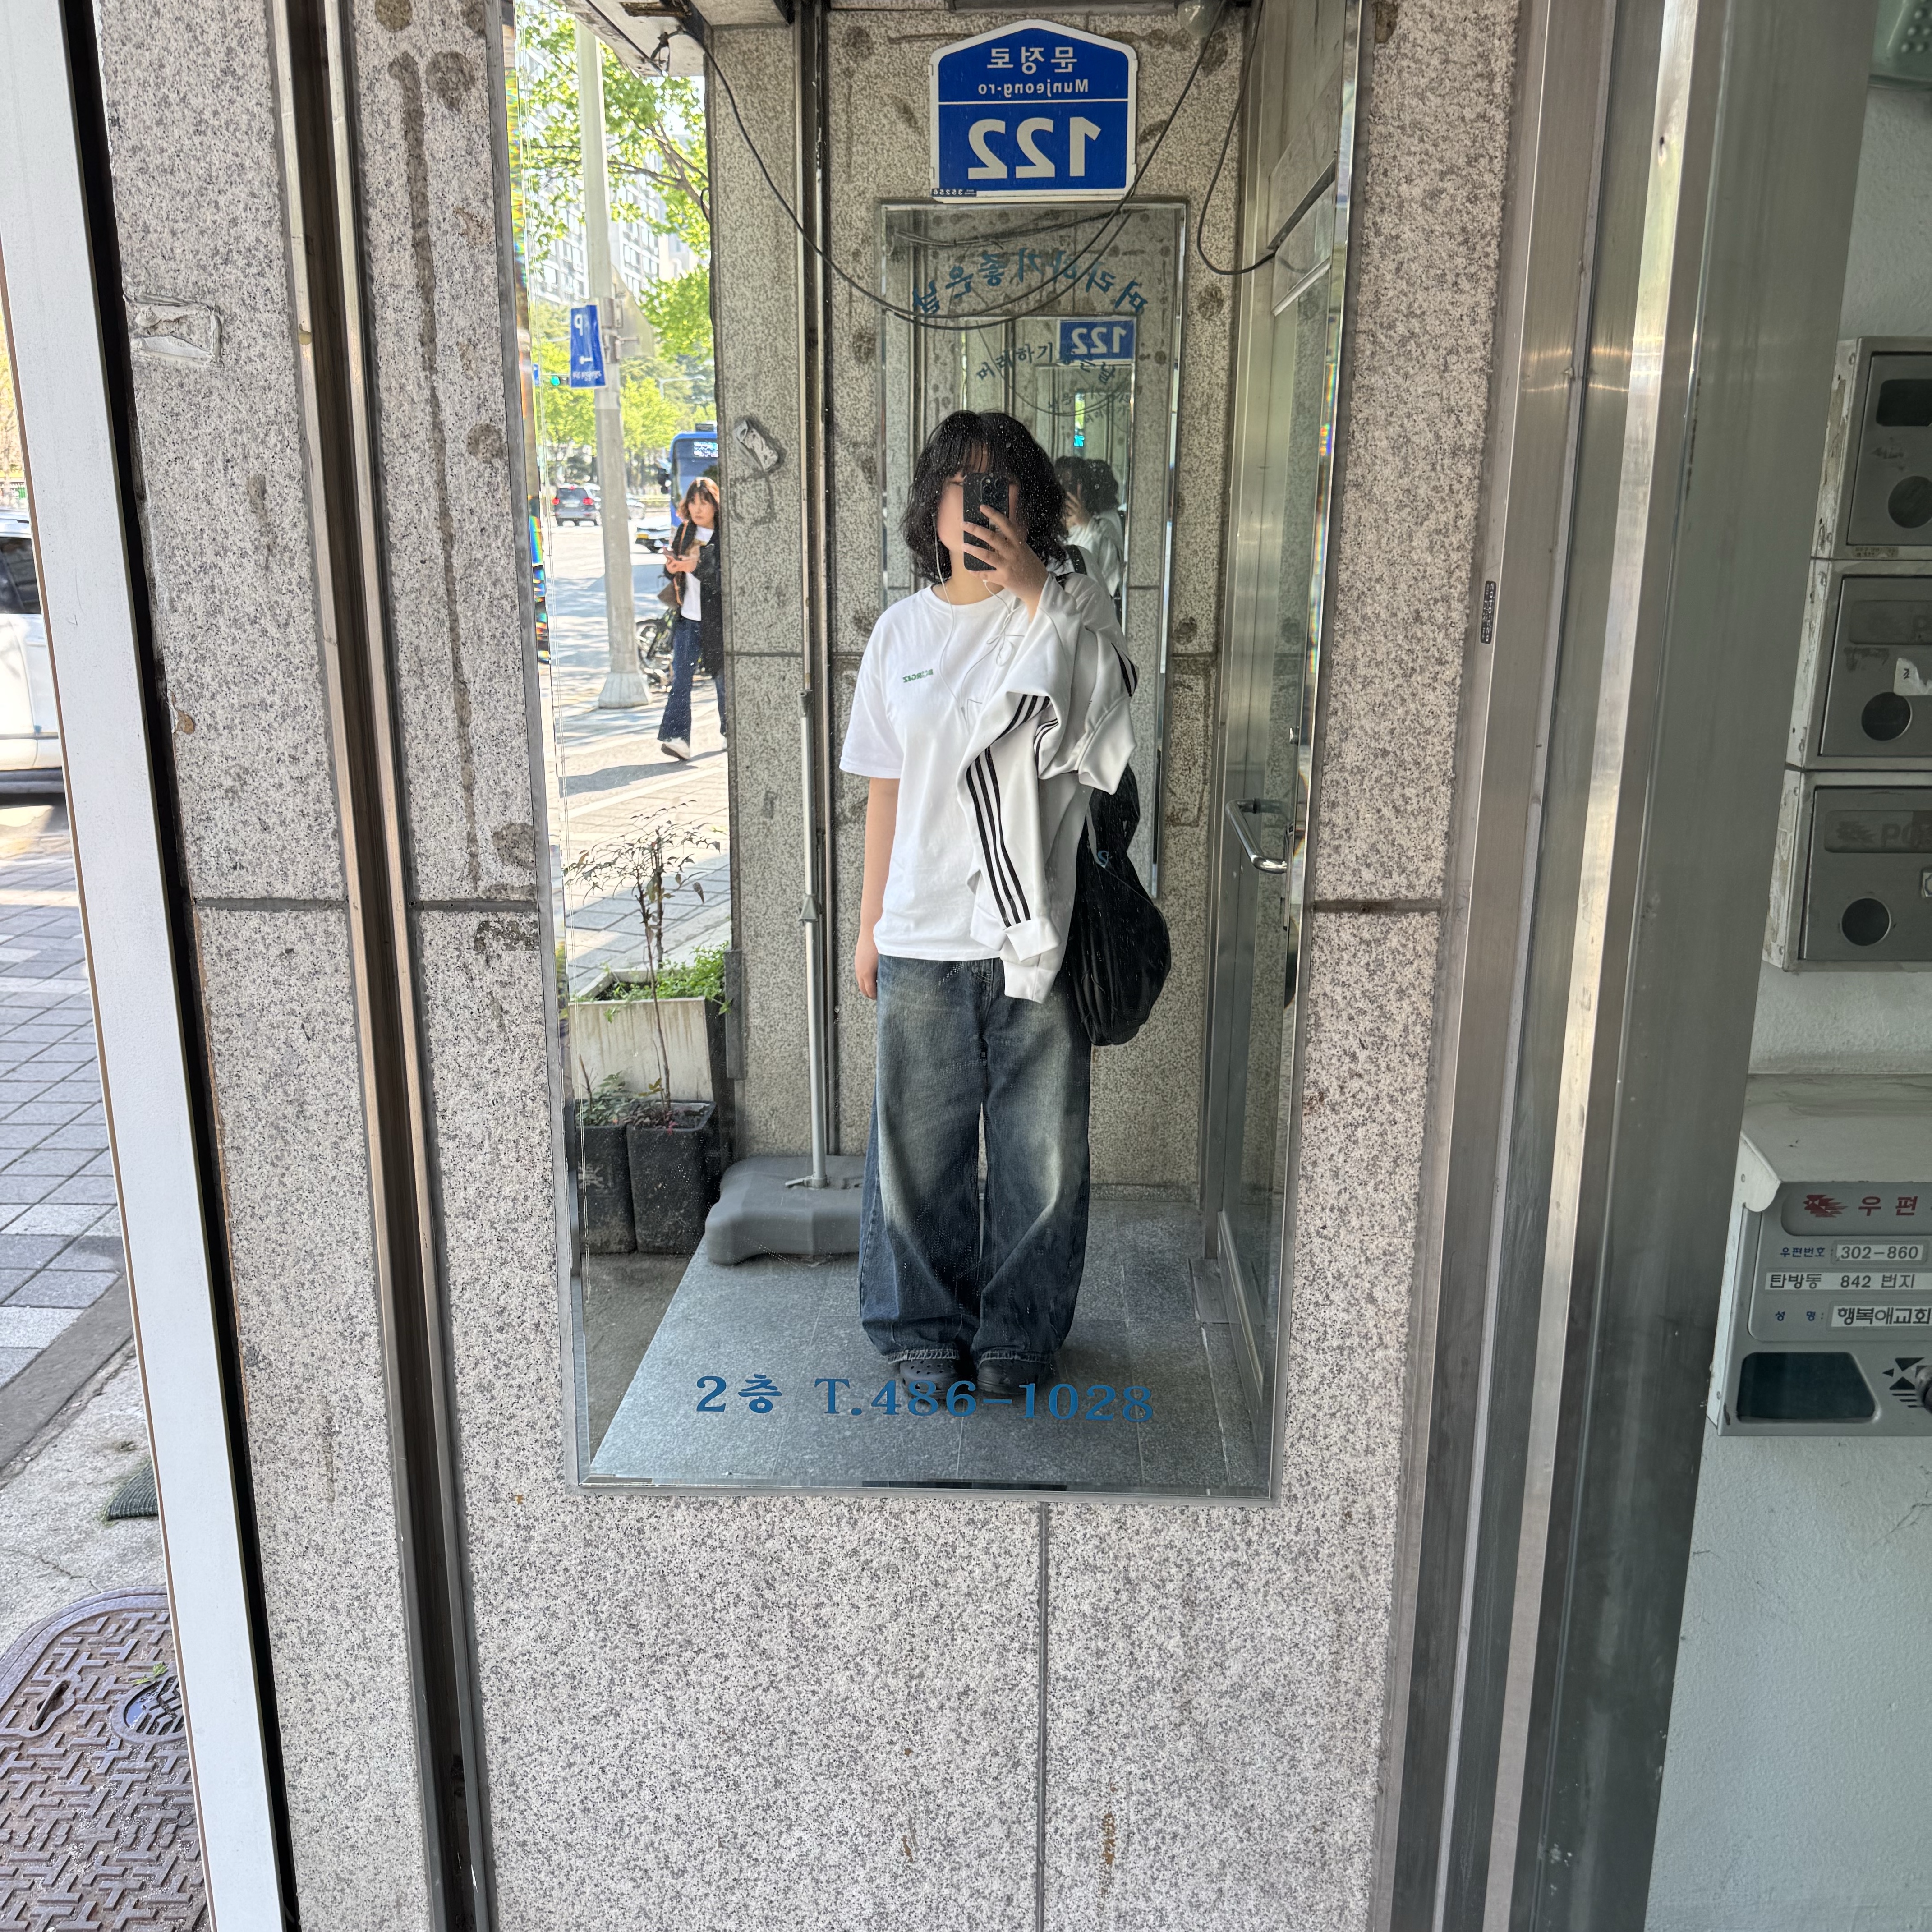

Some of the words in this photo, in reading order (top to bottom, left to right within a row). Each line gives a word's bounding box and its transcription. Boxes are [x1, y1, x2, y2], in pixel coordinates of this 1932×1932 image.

[1840, 1246, 1918, 1259] 302-860
[1770, 1274, 1822, 1289] 탄방동
[1840, 1274, 1872, 1288] 842
[1881, 1273, 1915, 1289] 번지
[1837, 1307, 1932, 1326] 행복애교회
[696, 1373, 782, 1413] 2층
